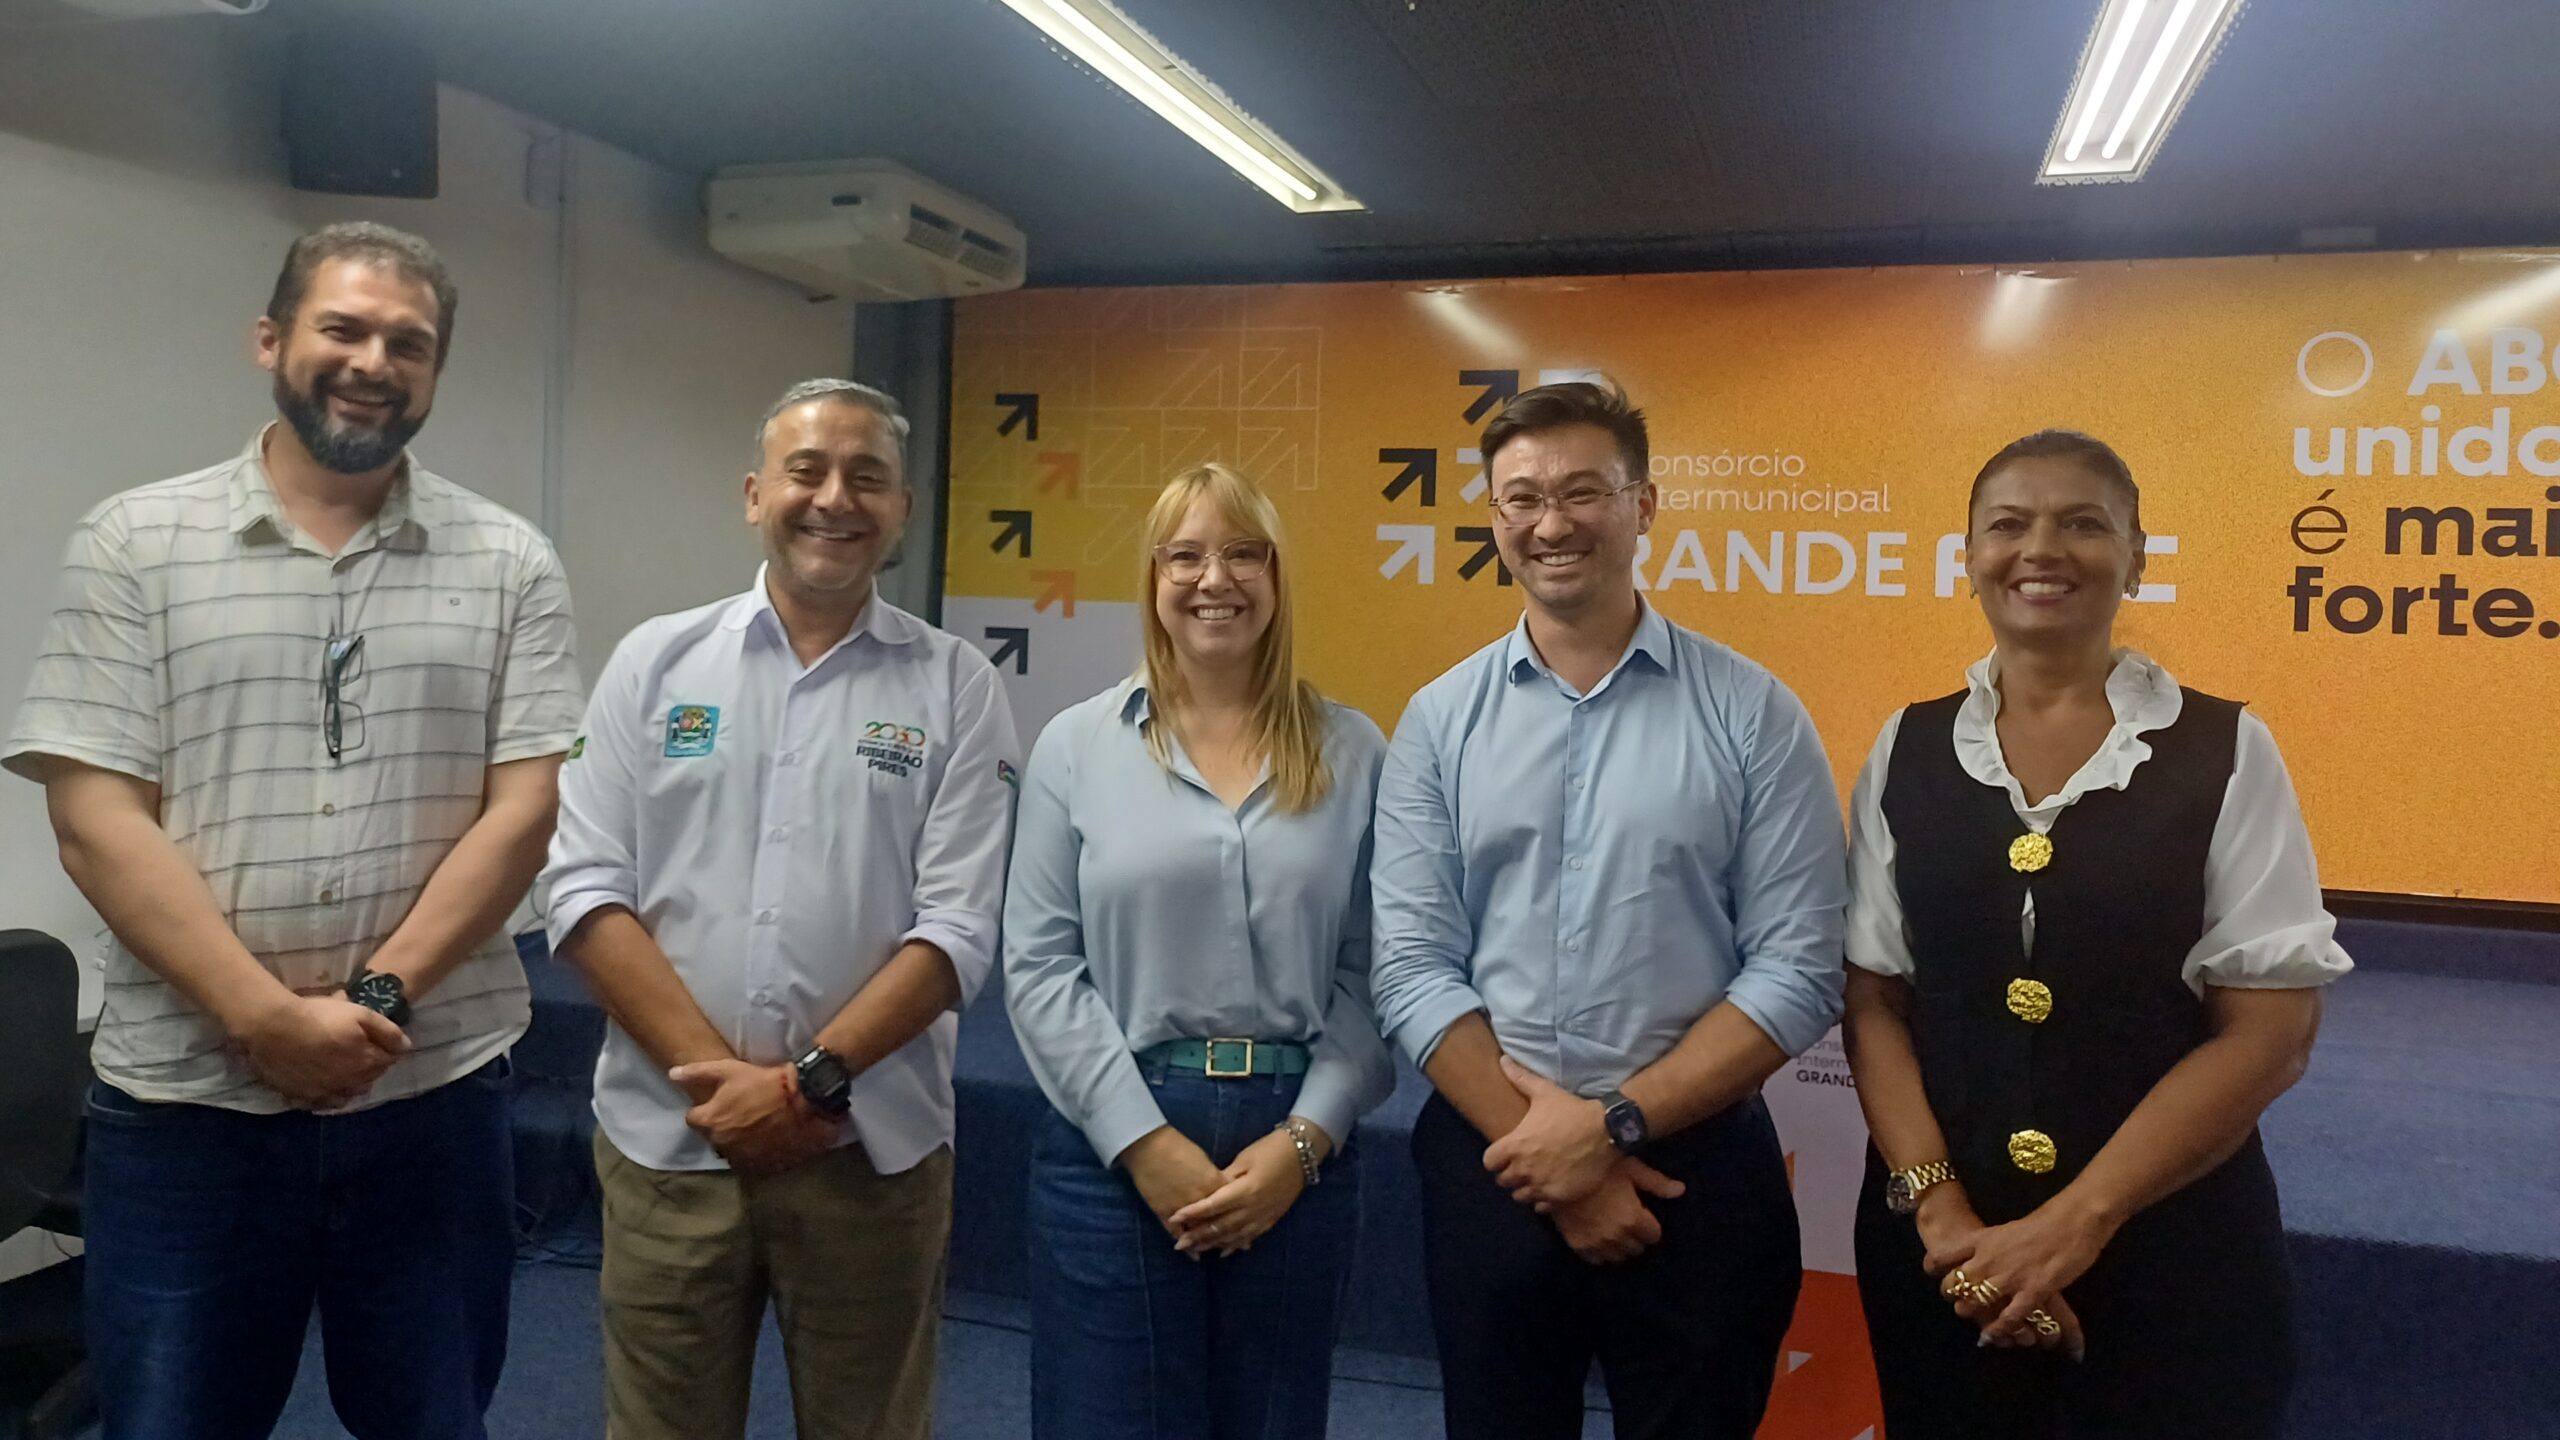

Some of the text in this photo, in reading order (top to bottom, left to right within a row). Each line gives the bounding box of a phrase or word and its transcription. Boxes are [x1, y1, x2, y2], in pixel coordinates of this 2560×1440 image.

[2296, 326, 2560, 397] O AB
[1650, 449, 1806, 478] onsórcio
[2293, 404, 2560, 477] unido
[1656, 483, 1892, 519] termunicipal
[2290, 488, 2348, 555] é
[2286, 565, 2560, 639] forte.
